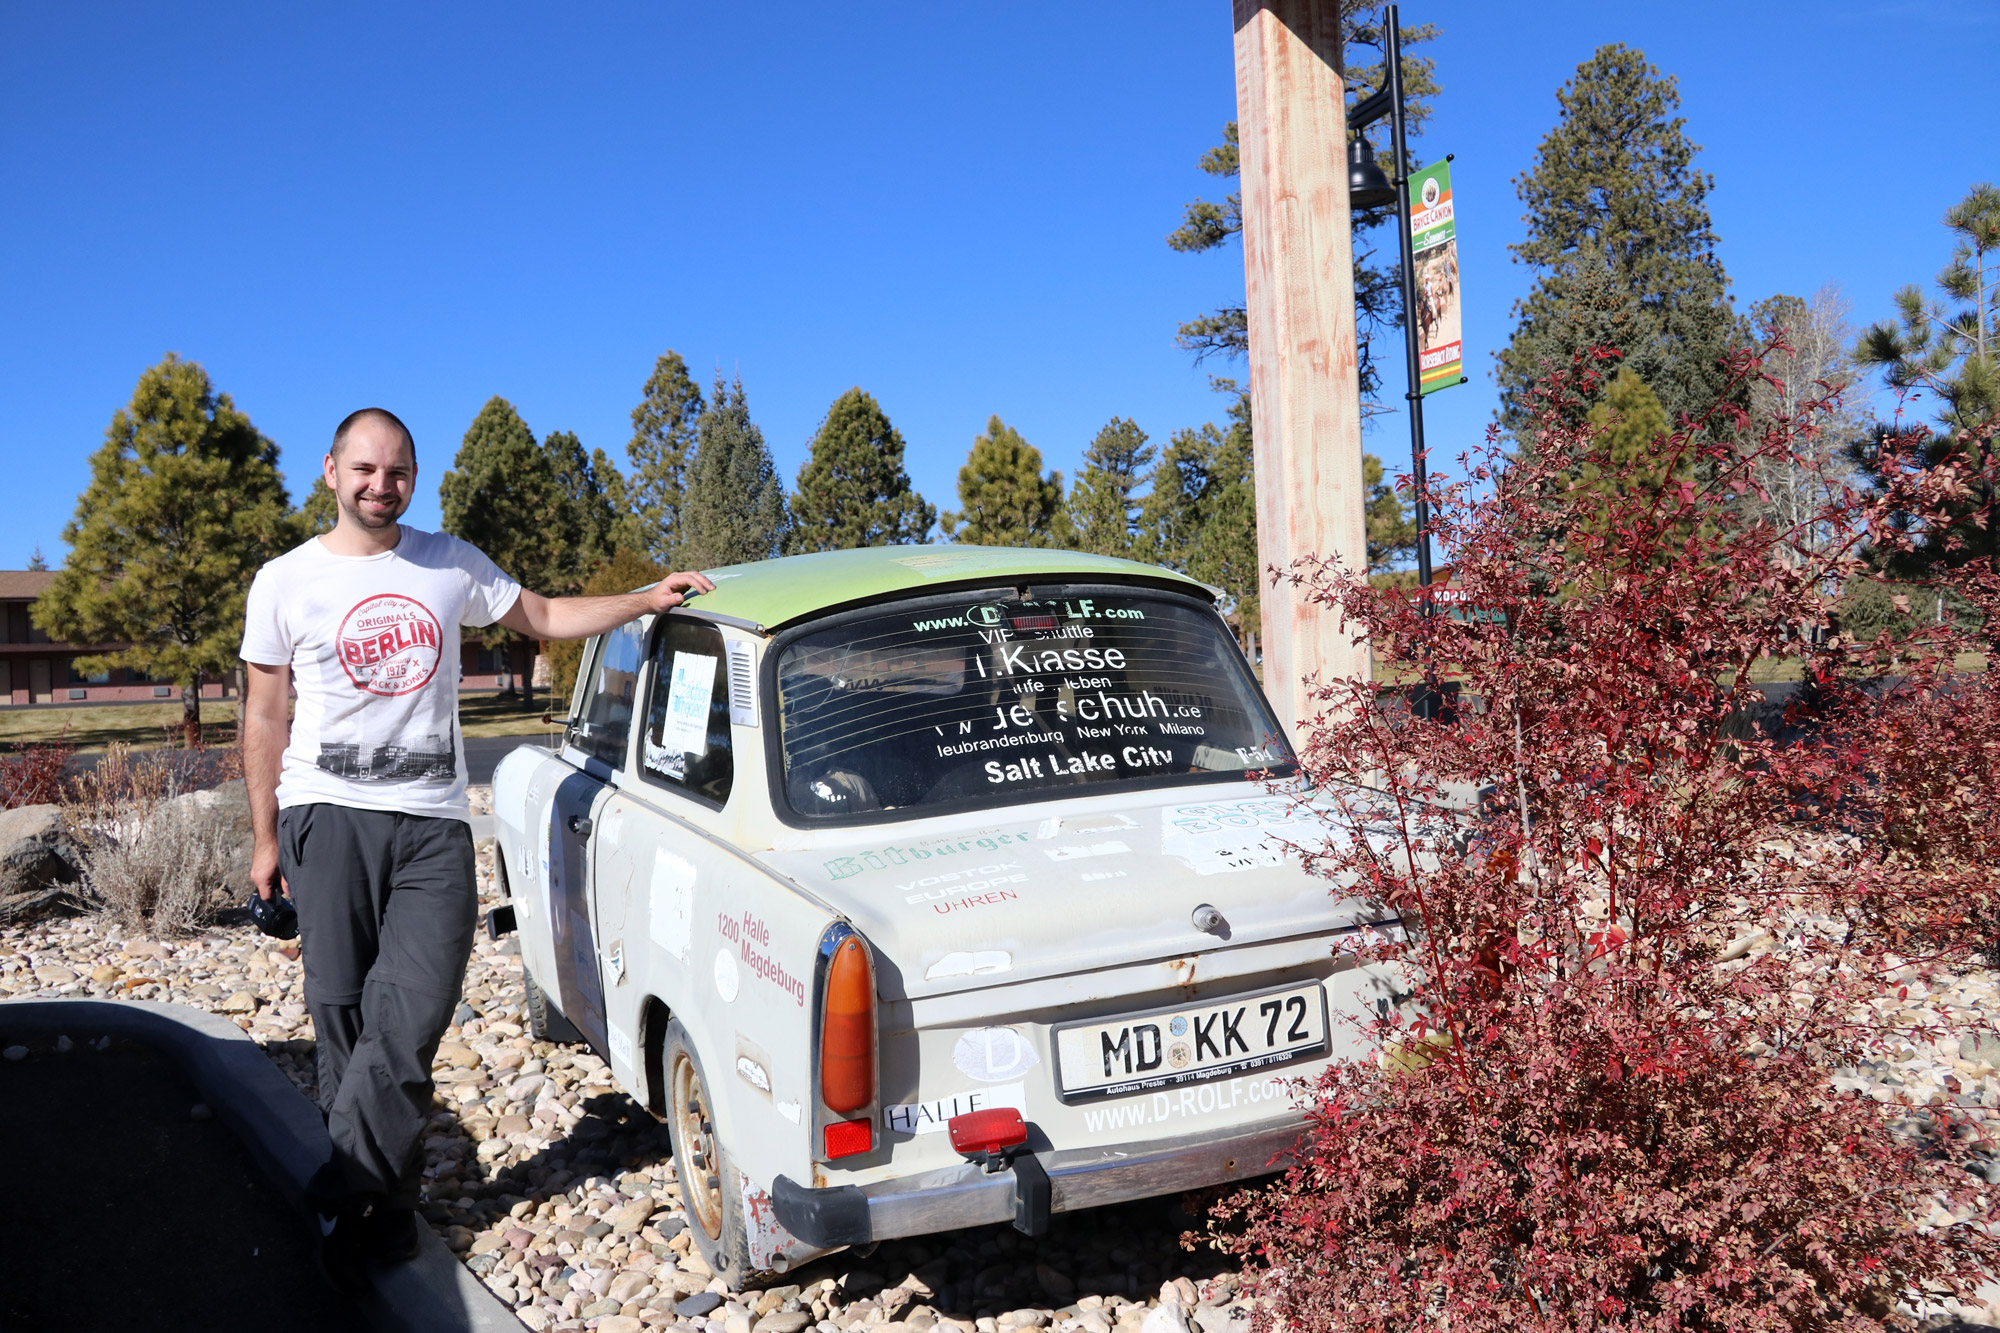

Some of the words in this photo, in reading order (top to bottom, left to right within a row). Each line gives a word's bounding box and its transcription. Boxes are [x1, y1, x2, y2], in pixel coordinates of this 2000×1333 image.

[1413, 213, 1429, 231] BRYCE
[1430, 205, 1452, 223] CANYON
[1421, 349, 1445, 370] HORSEBACK
[1445, 344, 1460, 363] RIDING
[356, 611, 416, 628] ORIGINALS
[358, 600, 382, 616] Capital
[384, 600, 397, 608] city
[343, 621, 436, 665] BERLIN
[367, 678, 391, 689] JACK
[401, 667, 429, 688] JONES
[386, 664, 406, 677] 1975
[1077, 726, 1111, 739] New
[1159, 722, 1205, 736] Milano
[984, 757, 1044, 784] Salt
[1048, 750, 1116, 776] Lake
[823, 830, 1029, 881] Bitburger
[895, 861, 1023, 891] VOSTOK
[905, 873, 1029, 905] EUROPE
[933, 889, 1018, 914] UHREN
[718, 912, 739, 943] 1200
[743, 910, 769, 947] Halle
[741, 939, 804, 1007] Magdeburg
[984, 1027, 1022, 1073] D
[1100, 1023, 1162, 1078] MD
[1193, 1007, 1250, 1062] KK
[1259, 995, 1309, 1047] 72
[1106, 1082, 1140, 1095] Autohaus
[1141, 1078, 1166, 1089] Prester
[1175, 1073, 1195, 1083] 39114
[1196, 1067, 1232, 1080] Magdeburg
[1250, 1058, 1265, 1068] 0391
[1083, 1074, 1292, 1133] www.D-ROLF.com
